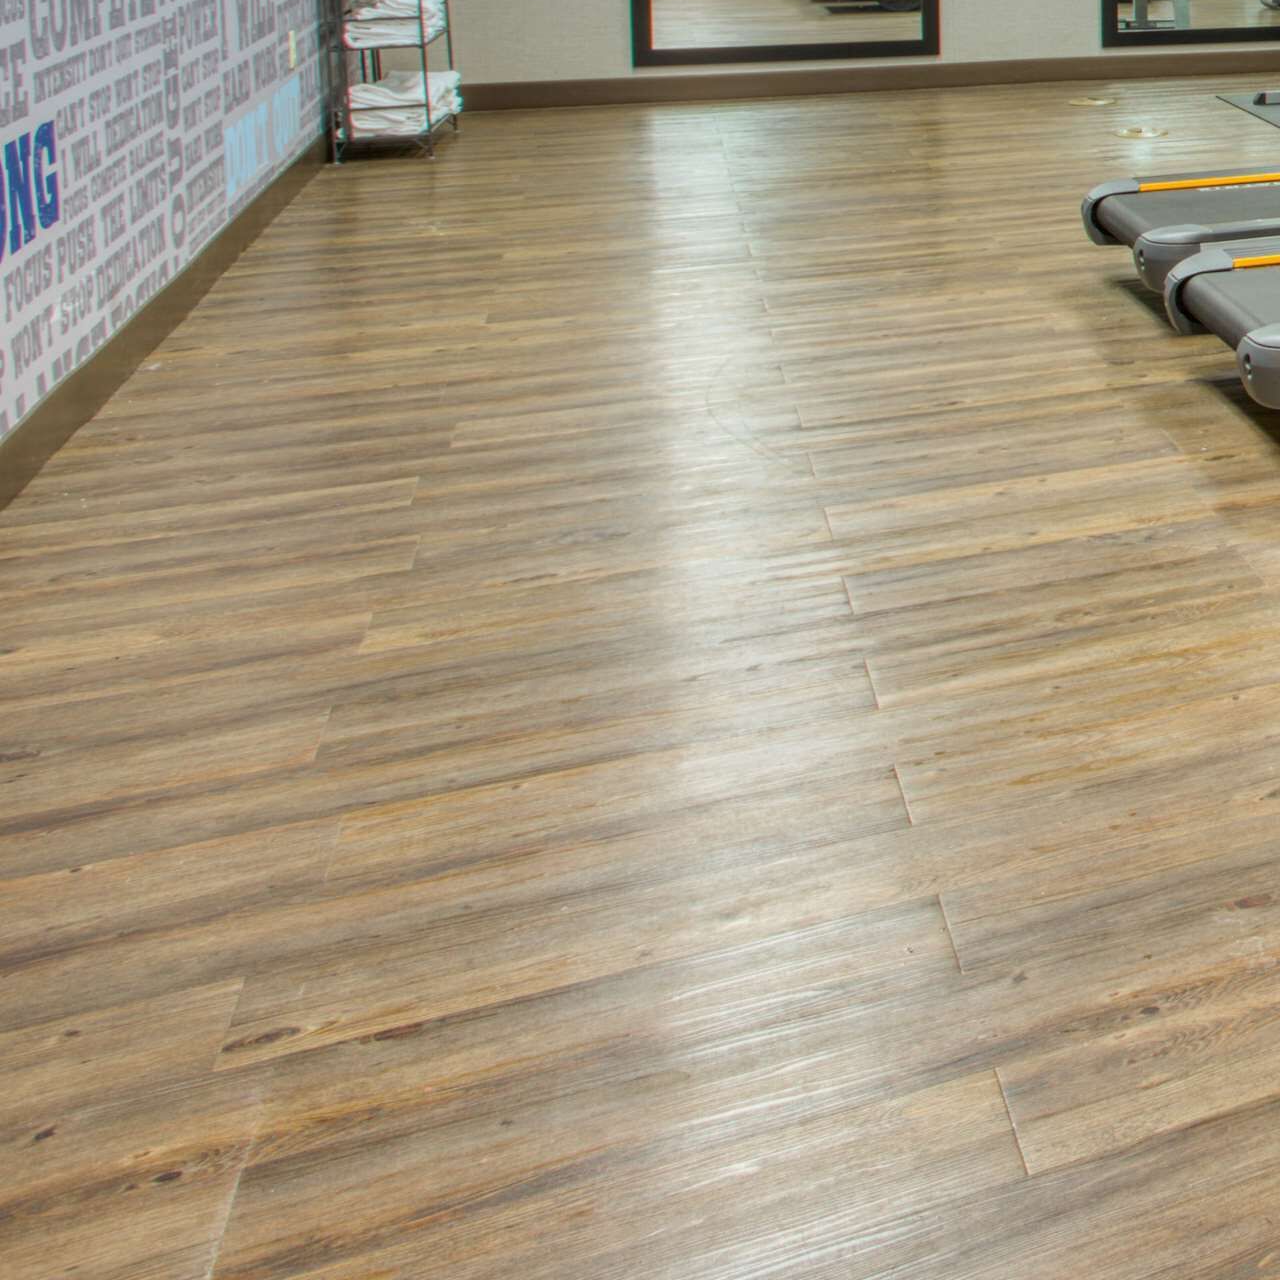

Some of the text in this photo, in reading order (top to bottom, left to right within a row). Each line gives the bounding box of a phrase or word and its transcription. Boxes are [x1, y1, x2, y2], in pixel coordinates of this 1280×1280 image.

[33, 50, 87, 105] INTENSITY
[71, 127, 101, 183] WILL
[104, 88, 163, 158] DEDICATION
[161, 16, 187, 268] OUGH
[0, 113, 60, 264] NG
[3, 241, 52, 329] FOCUS
[55, 210, 95, 288] PUSH
[99, 187, 127, 253] THE
[128, 158, 167, 228] LIMITS
[10, 301, 54, 386] WON'T
[58, 270, 93, 343] STOP
[94, 210, 166, 315] DEDICATION
